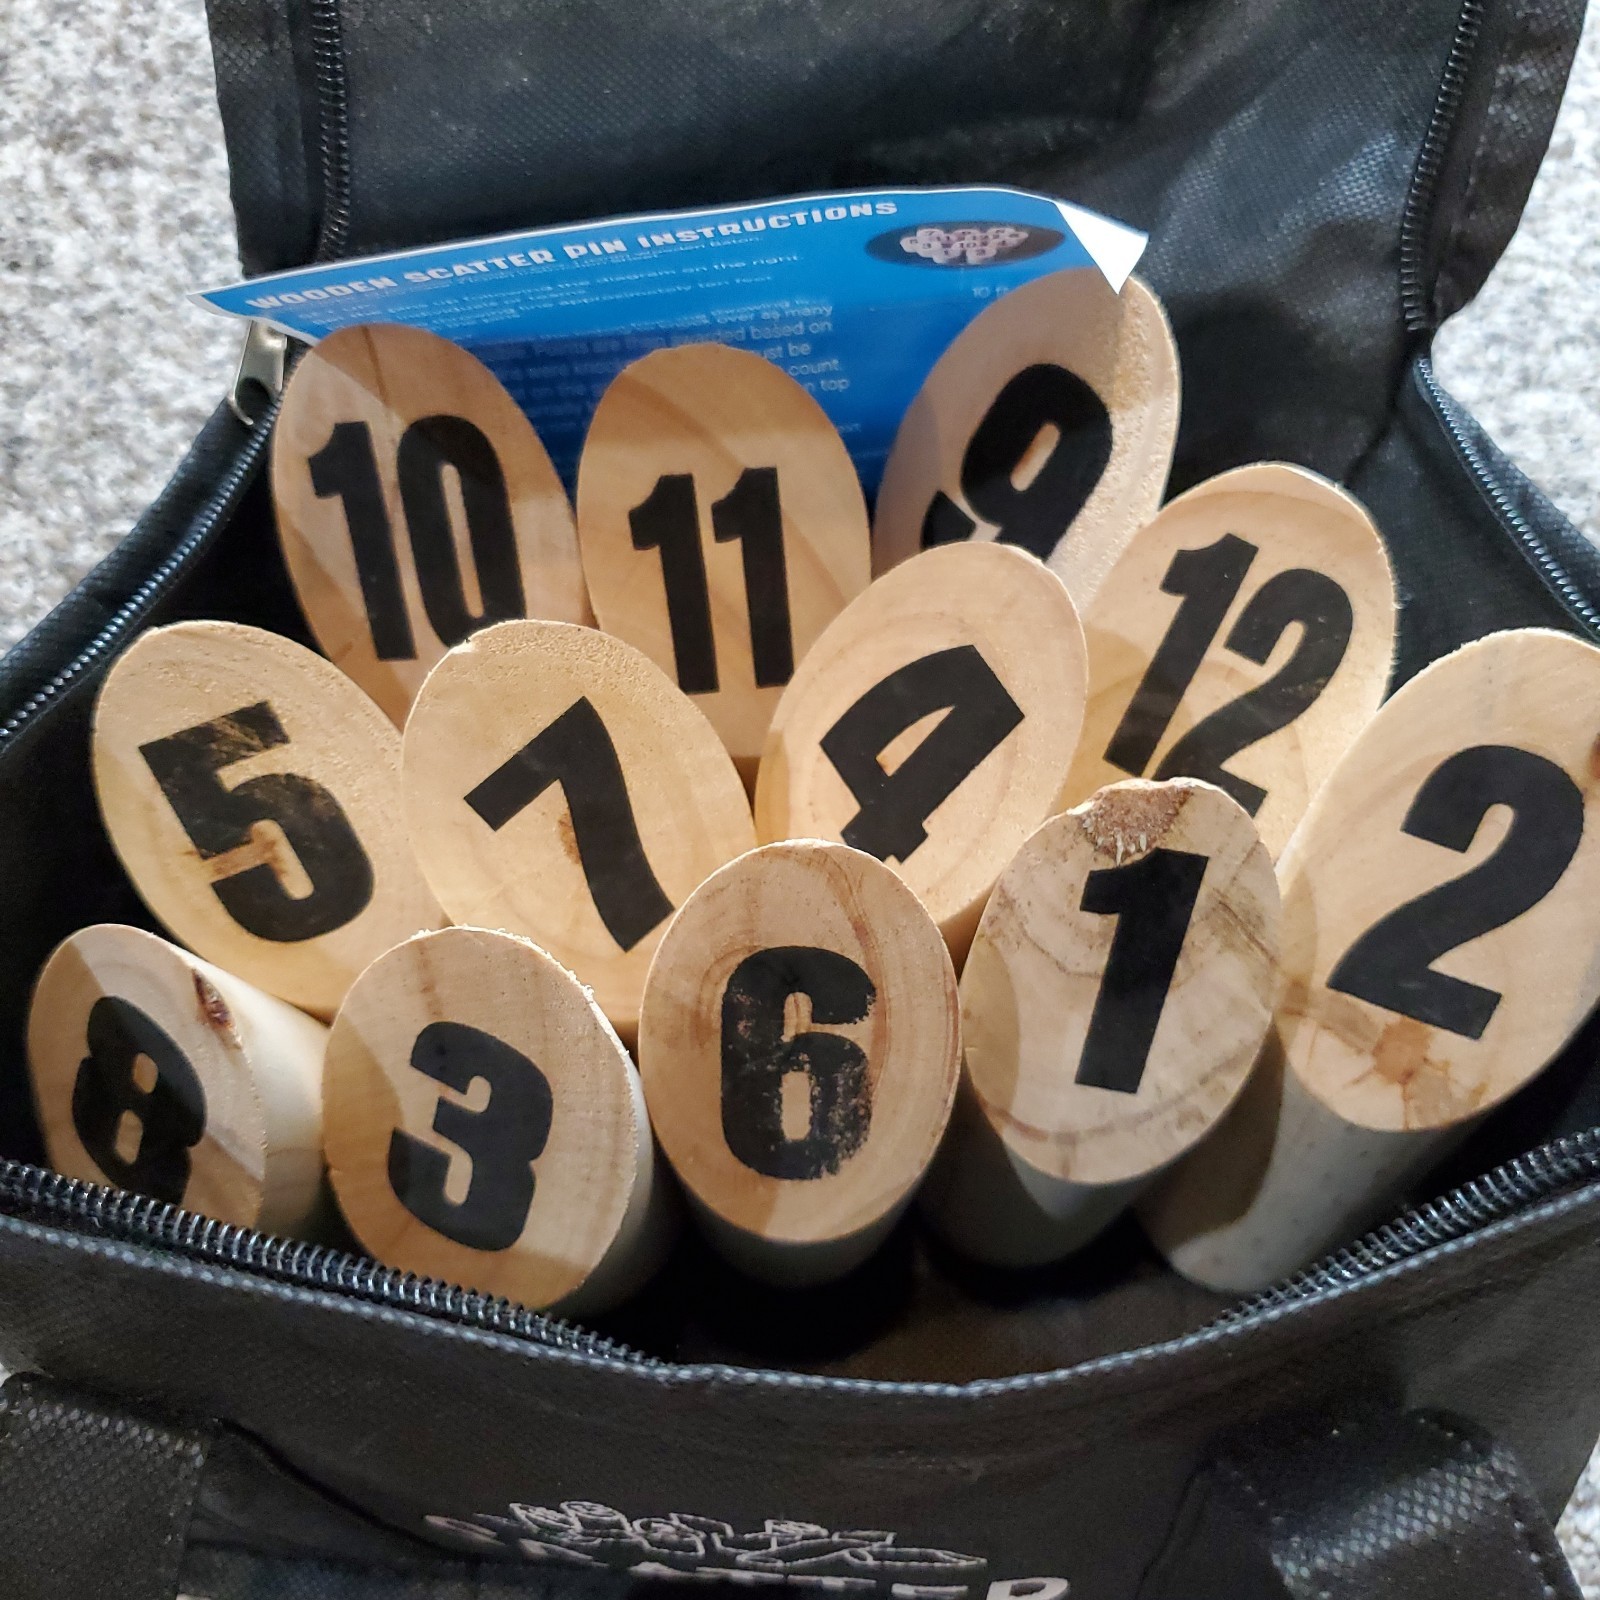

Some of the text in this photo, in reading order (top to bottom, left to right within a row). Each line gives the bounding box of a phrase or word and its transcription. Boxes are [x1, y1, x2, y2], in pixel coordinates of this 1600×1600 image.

[246, 277, 397, 309] WOODEN
[404, 249, 556, 283] SCATTER
[562, 239, 627, 259] PIN
[637, 202, 898, 248] INSTRUCTIONS
[751, 321, 805, 340] based
[809, 321, 832, 334] on
[785, 305, 833, 317] many
[788, 342, 811, 357] be
[820, 378, 849, 392] top
[921, 363, 1113, 562] 9
[309, 415, 526, 661] 10
[628, 467, 795, 694] 11
[820, 645, 1025, 863] 4
[1102, 533, 1353, 817] 12
[138, 701, 374, 942] 5
[463, 695, 675, 952] 7
[1327, 745, 1585, 1041] 2
[721, 945, 877, 1181] 6
[1075, 849, 1209, 1094] 1
[72, 995, 207, 1205] 8
[388, 1022, 553, 1251] 3
